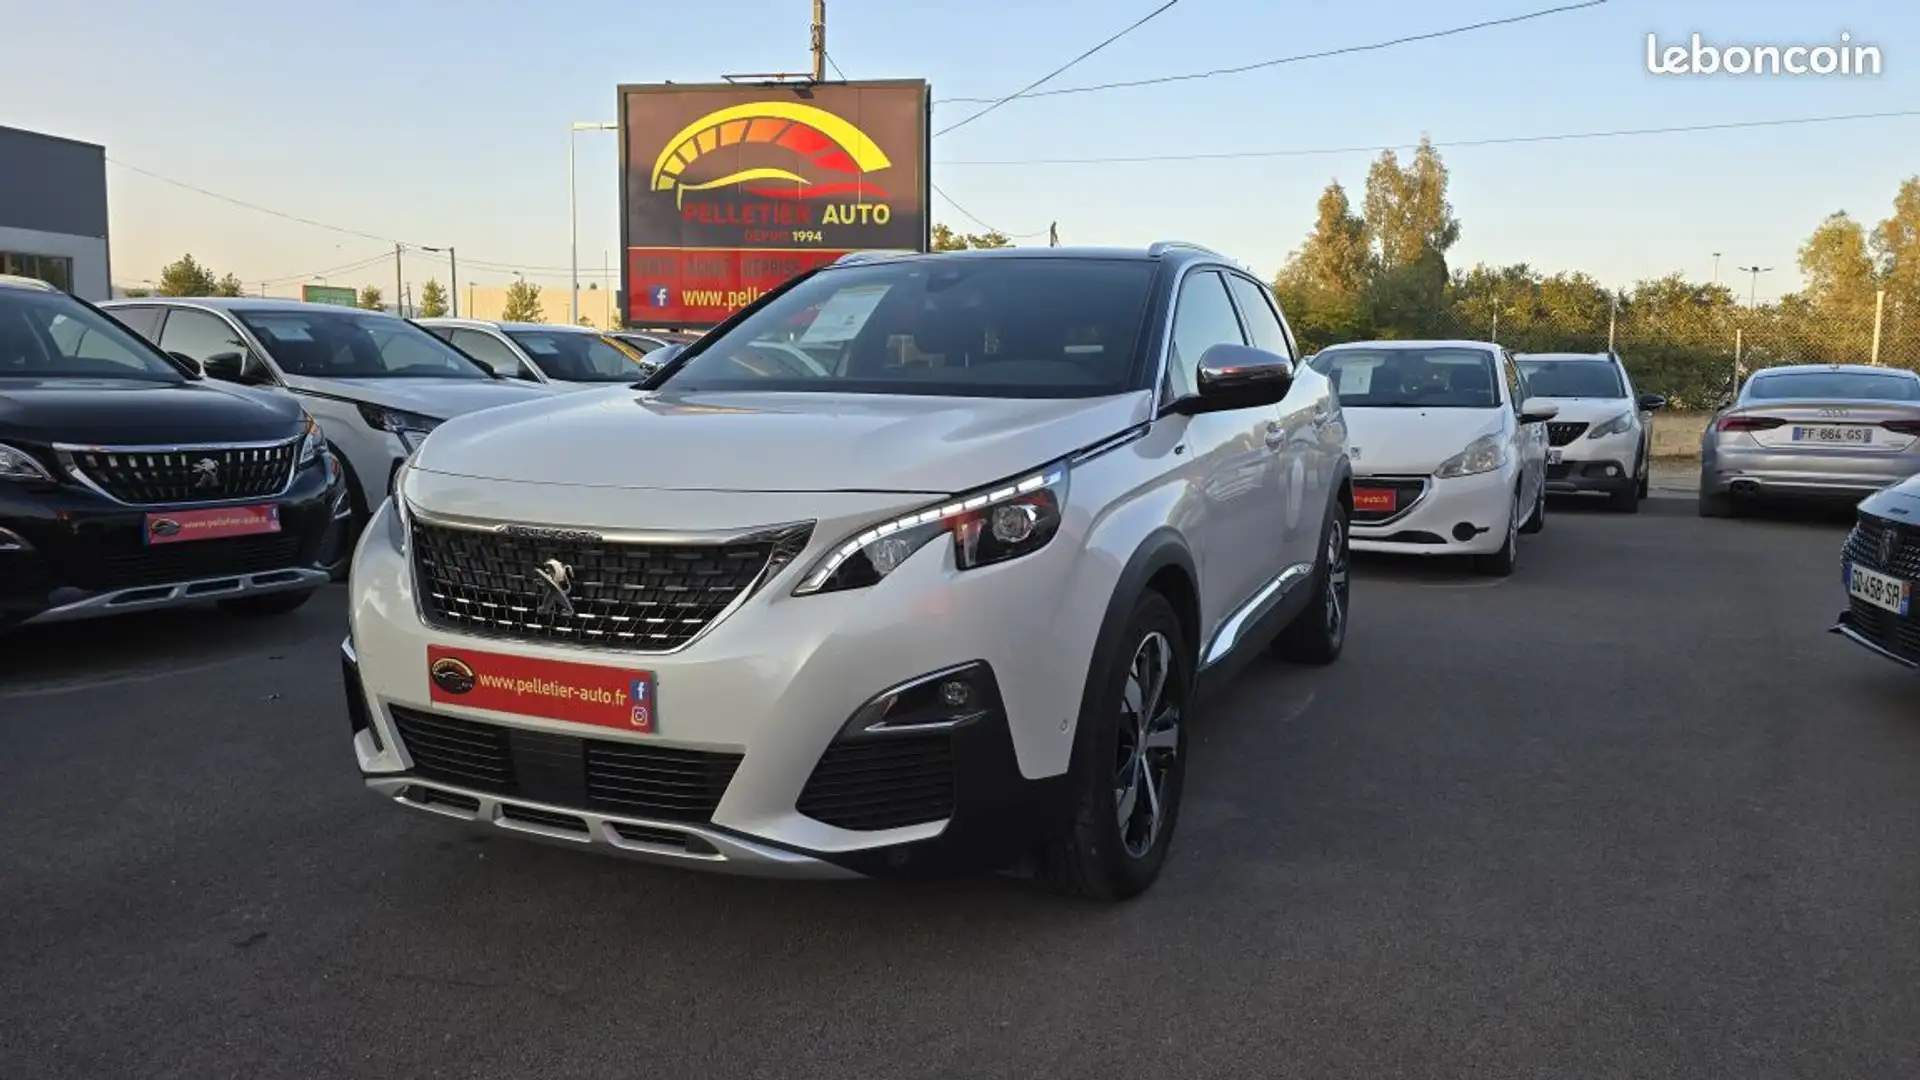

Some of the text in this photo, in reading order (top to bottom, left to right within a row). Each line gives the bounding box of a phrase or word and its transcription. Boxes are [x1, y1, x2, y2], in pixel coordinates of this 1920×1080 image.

[681, 202, 892, 226] PELLETIER AUTO
[791, 229, 824, 243] 1994
[479, 673, 628, 706] www.pelletier-auto.fr
